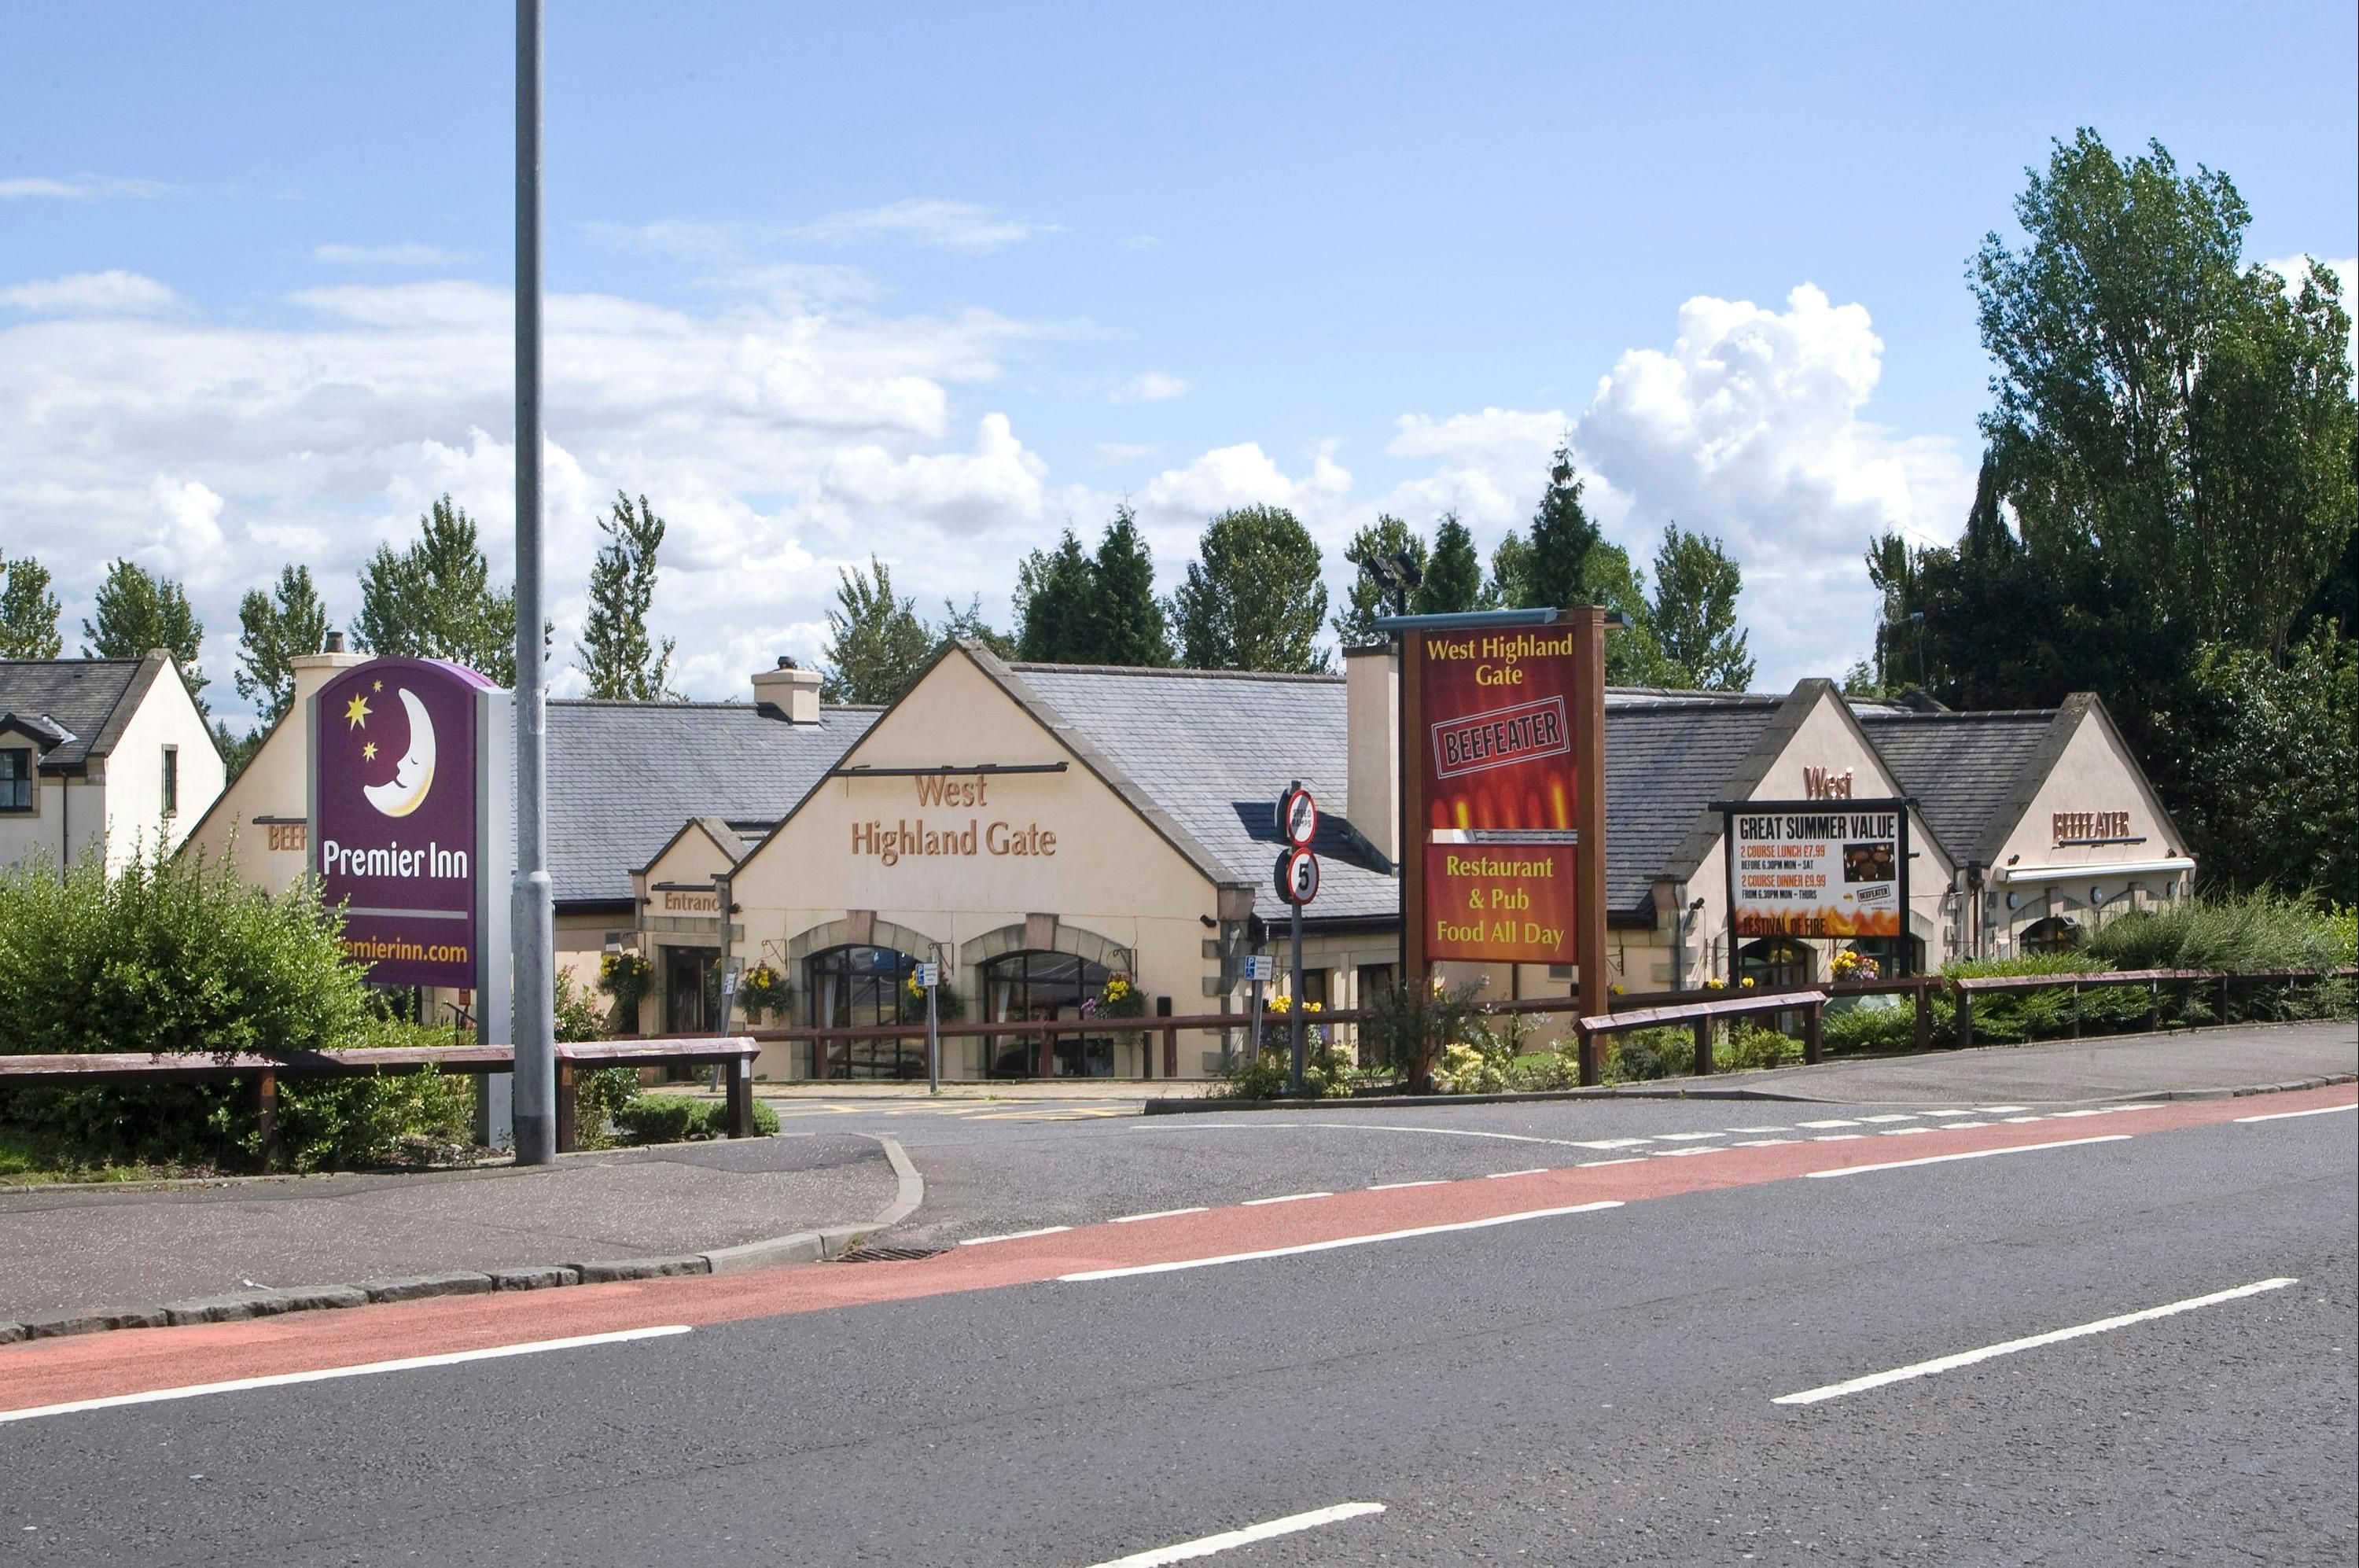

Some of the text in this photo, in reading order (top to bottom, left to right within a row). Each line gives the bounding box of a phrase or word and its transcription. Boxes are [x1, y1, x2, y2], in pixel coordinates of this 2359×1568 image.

[1427, 633, 1573, 664] West Highland
[1475, 664, 1523, 686] Gate
[1443, 710, 1561, 767] BEEFEATER
[915, 775, 988, 807] West
[1803, 766, 1854, 800] West
[1739, 815, 1895, 840] GREAT SUMMER VALUE
[2052, 811, 2129, 840] BEEFEATER
[852, 819, 1057, 867] Highland Gate
[1740, 846, 1746, 858] 2
[1747, 845, 1776, 857] COURSE
[1777, 845, 1801, 857] LUNCH
[323, 840, 468, 878] Premier Inn
[1446, 856, 1554, 878] Restaurant
[1741, 860, 1761, 870] BEFORE
[1783, 860, 1797, 870] MON
[1803, 860, 1813, 870] SAT
[1298, 863, 1309, 891] 5
[1742, 874, 1746, 887] 2
[1748, 874, 1776, 887] COURSE
[1777, 874, 1803, 887] DINNER
[665, 893, 719, 911] Entranc
[1469, 888, 1529, 909] & Pub
[1742, 890, 1757, 900] FROM
[1779, 889, 1793, 899] MON
[1799, 889, 1817, 900] THURS
[1437, 920, 1565, 952] Food All Day
[1743, 917, 1825, 936] FESTIVAL OF FIRE
